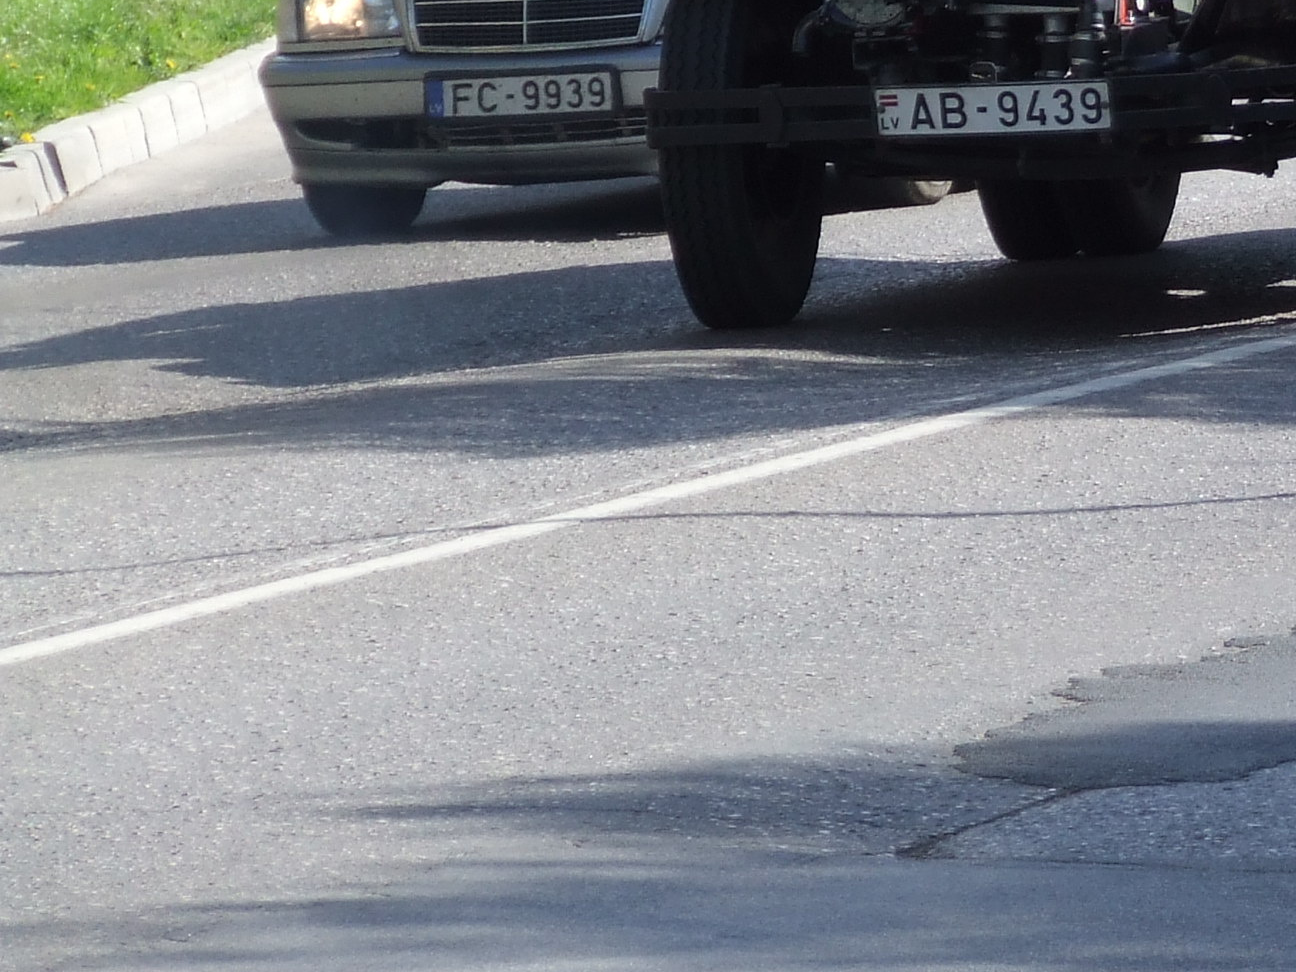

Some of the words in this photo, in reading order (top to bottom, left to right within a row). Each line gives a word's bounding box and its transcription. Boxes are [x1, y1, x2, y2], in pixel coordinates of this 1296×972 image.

[452, 77, 606, 115] FC-9939
[910, 87, 1102, 130] AB-9439
[880, 117, 900, 130] LV
